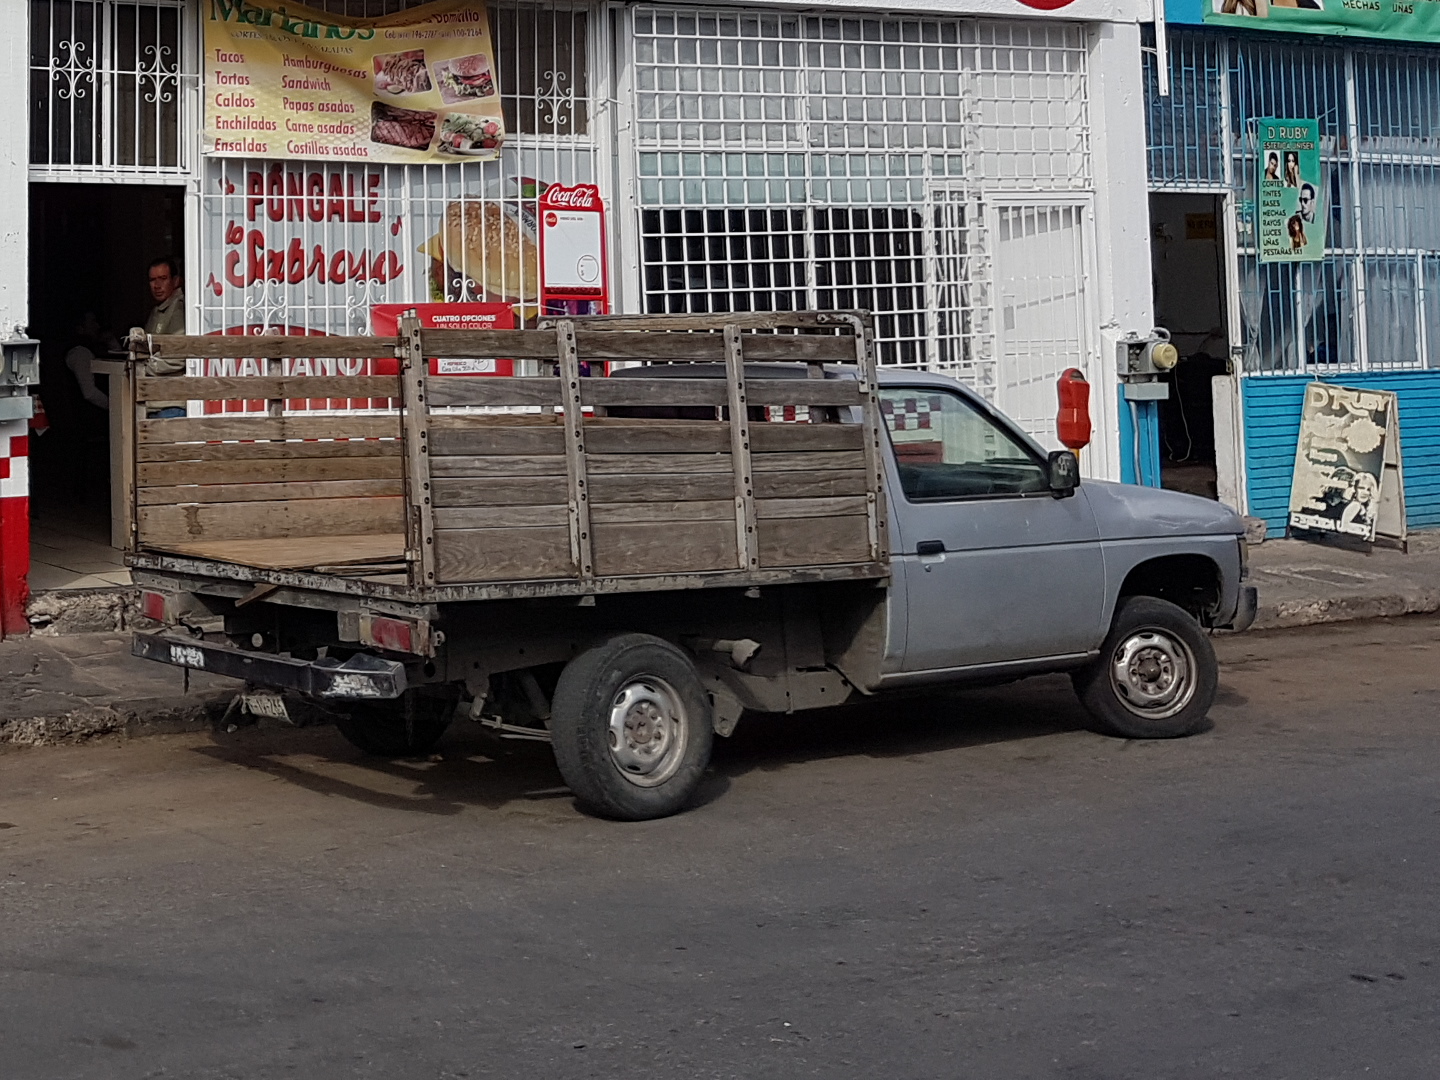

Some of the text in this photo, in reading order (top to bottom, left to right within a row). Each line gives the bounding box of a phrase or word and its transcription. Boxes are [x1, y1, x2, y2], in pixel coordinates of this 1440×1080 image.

[1342, 0, 1380, 11] MECHAS
[1392, 2, 1414, 14] UÑAS
[215, 48, 245, 63] Tacos
[215, 71, 250, 85] Tortas
[281, 75, 331, 91] Sandwich
[215, 93, 255, 108] Caldos
[282, 96, 355, 114] Papas asadas
[215, 115, 277, 131] Enchiladas
[285, 118, 355, 135] Carne asadas
[214, 137, 267, 153] Ensaldas
[286, 140, 368, 157] Costillas asadas
[1262, 180, 1284, 188] CORTES
[547, 186, 595, 207] Coca-Cola
[1262, 219, 1281, 227] RAYOS
[225, 229, 404, 288] Sabroso
[432, 314, 497, 323] CUATRO OPCIONES
